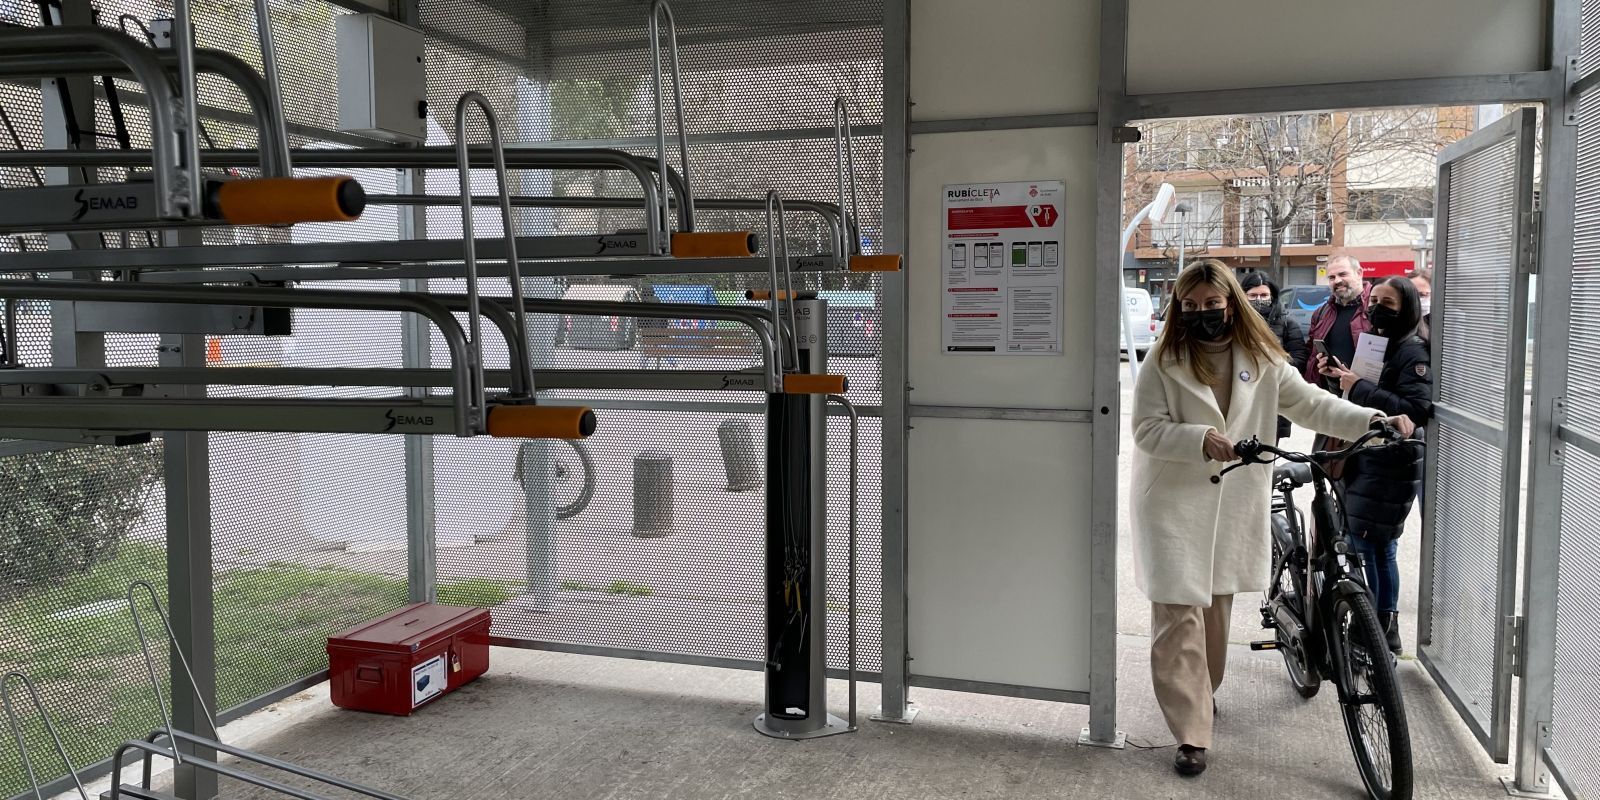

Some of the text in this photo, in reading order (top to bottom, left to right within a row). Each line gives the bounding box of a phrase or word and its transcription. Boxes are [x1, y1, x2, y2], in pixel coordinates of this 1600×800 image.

[72, 189, 138, 221] SEMAB
[594, 236, 637, 255] SEMAB
[795, 259, 824, 271] SEMAB
[721, 375, 754, 389] SEMAB
[383, 409, 434, 431] SEMAB
